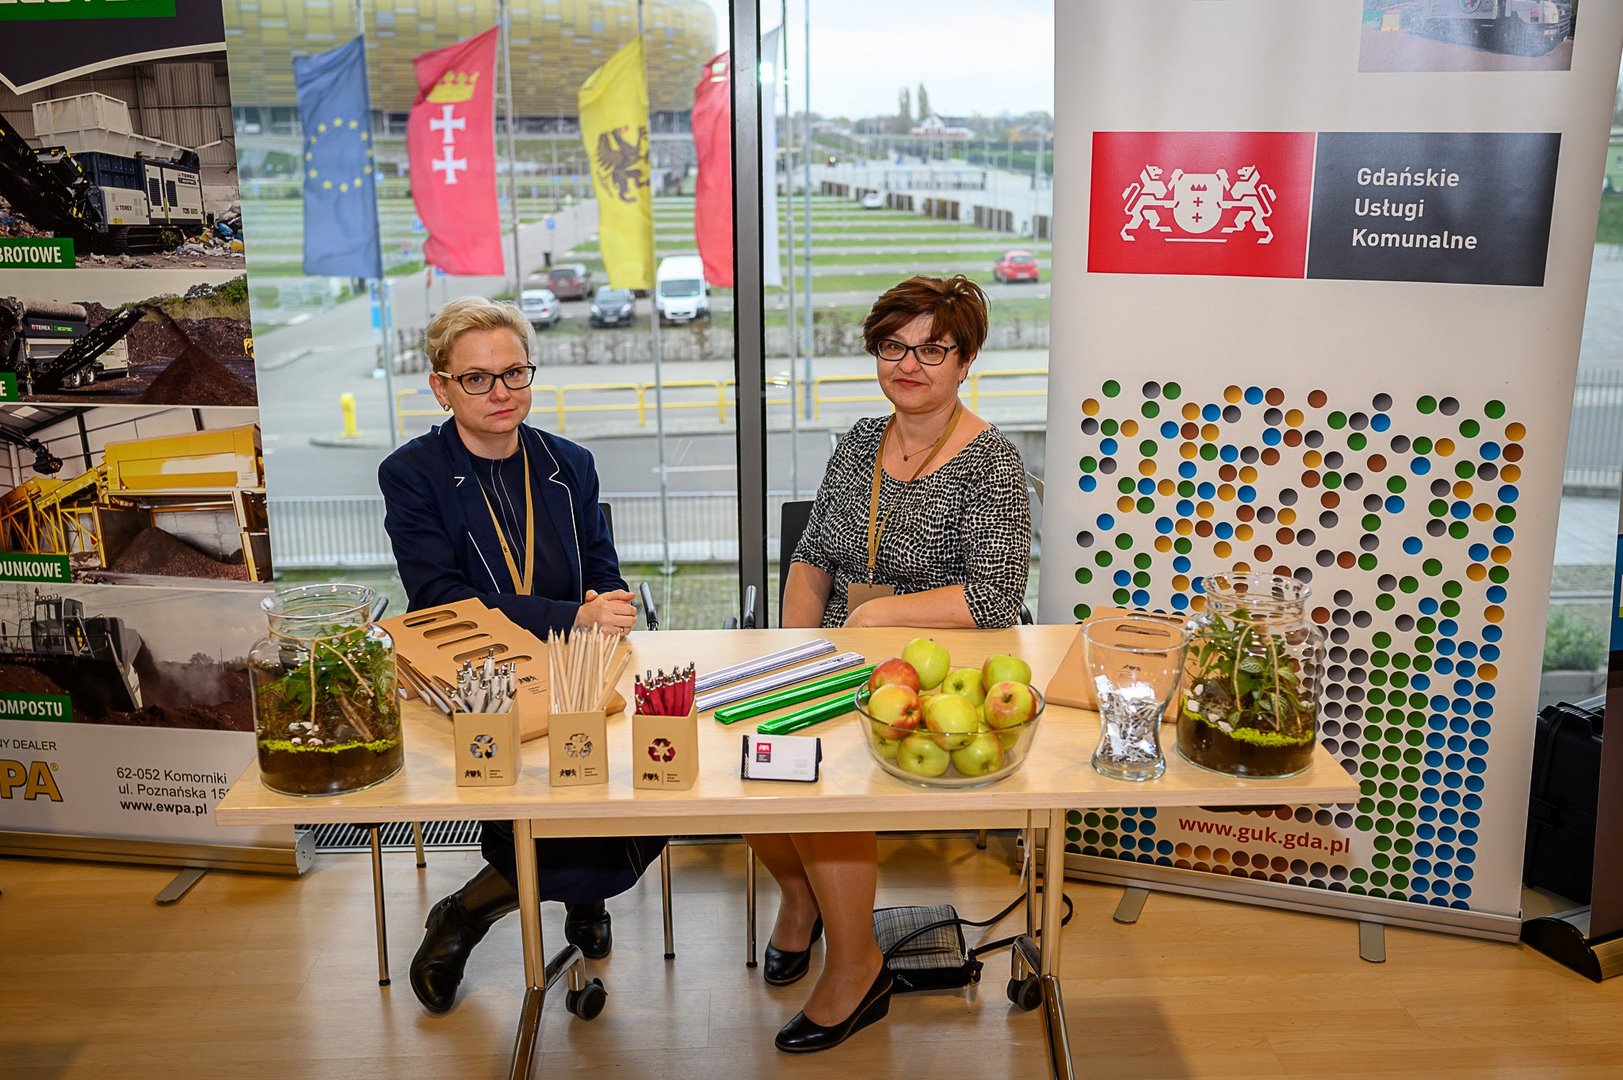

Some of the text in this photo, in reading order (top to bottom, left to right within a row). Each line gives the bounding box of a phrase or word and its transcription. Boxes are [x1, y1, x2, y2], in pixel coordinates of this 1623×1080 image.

[1357, 166, 1460, 187] Gdańskie
[1354, 198, 1425, 222] Usługi
[1352, 228, 1478, 250] Komunalne
[13, 739, 57, 751] DEALER
[116, 766, 227, 784] 62-052 Komorniki
[118, 783, 231, 800] ul. Poznańska 15
[120, 800, 208, 817] www.ewpa.pl
[1178, 818, 1351, 856] www.guk.gda.pl
